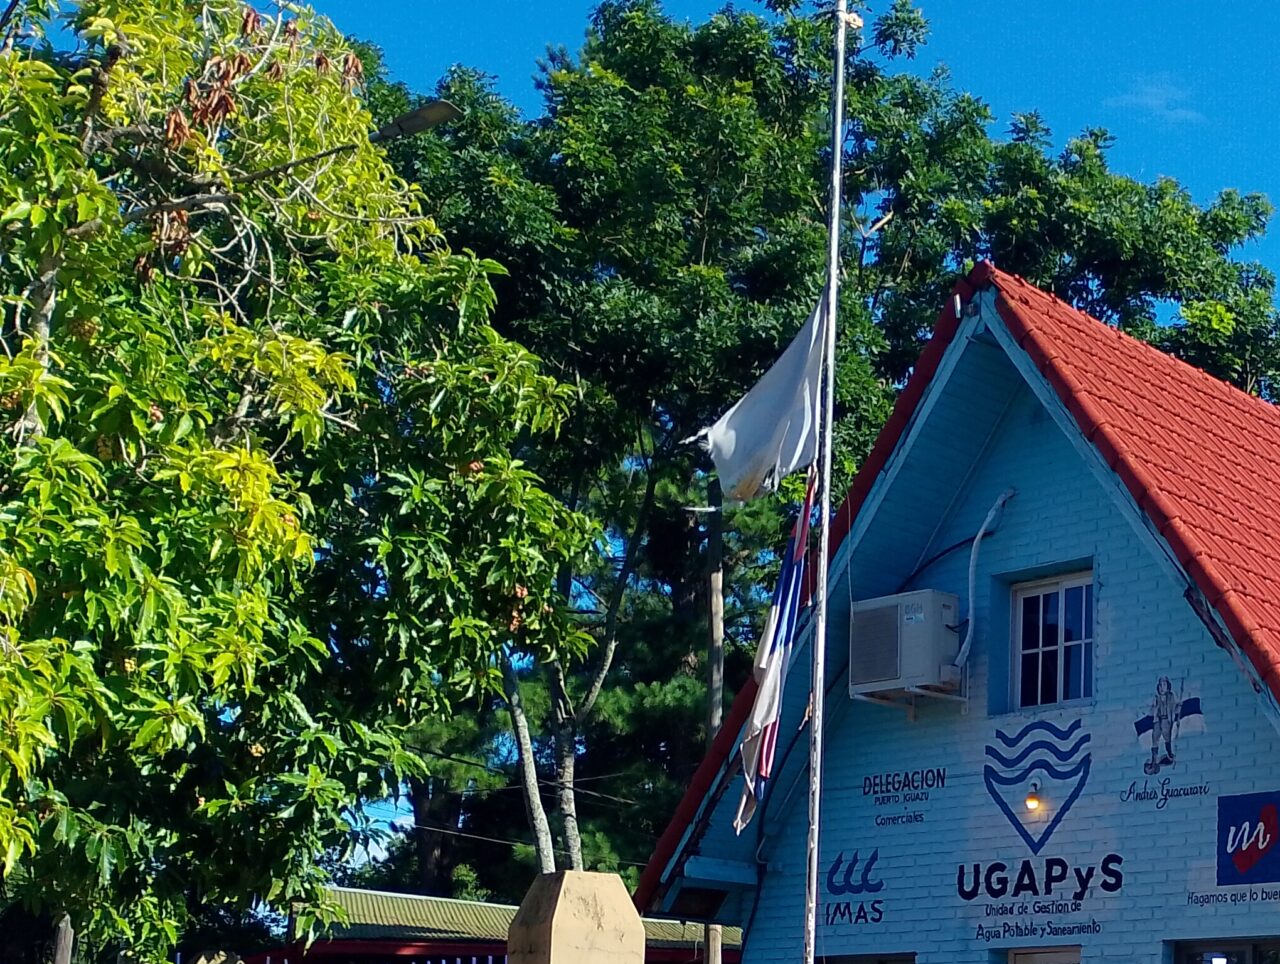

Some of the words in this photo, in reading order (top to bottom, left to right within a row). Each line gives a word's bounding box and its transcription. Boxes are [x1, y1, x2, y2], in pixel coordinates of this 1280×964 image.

[863, 768, 946, 795] DELEGACION
[874, 795, 900, 806] PUERTO
[904, 792, 930, 803] IGUAZU
[875, 811, 925, 827] Comerciales
[957, 853, 1124, 901] UGAPyS
[985, 902, 1014, 916] Unidad
[1018, 902, 1029, 914] de
[1033, 900, 1069, 914] Gestion
[1071, 901, 1082, 912] de
[1187, 890, 1228, 907] Hagamos
[1230, 891, 1247, 906] que
[1249, 888, 1258, 901] lo
[825, 900, 884, 926] IMAS
[976, 924, 1001, 942] Agua
[1003, 921, 1038, 939] Potable
[1040, 927, 1046, 938] y
[1047, 919, 1101, 937] Saneamiento
